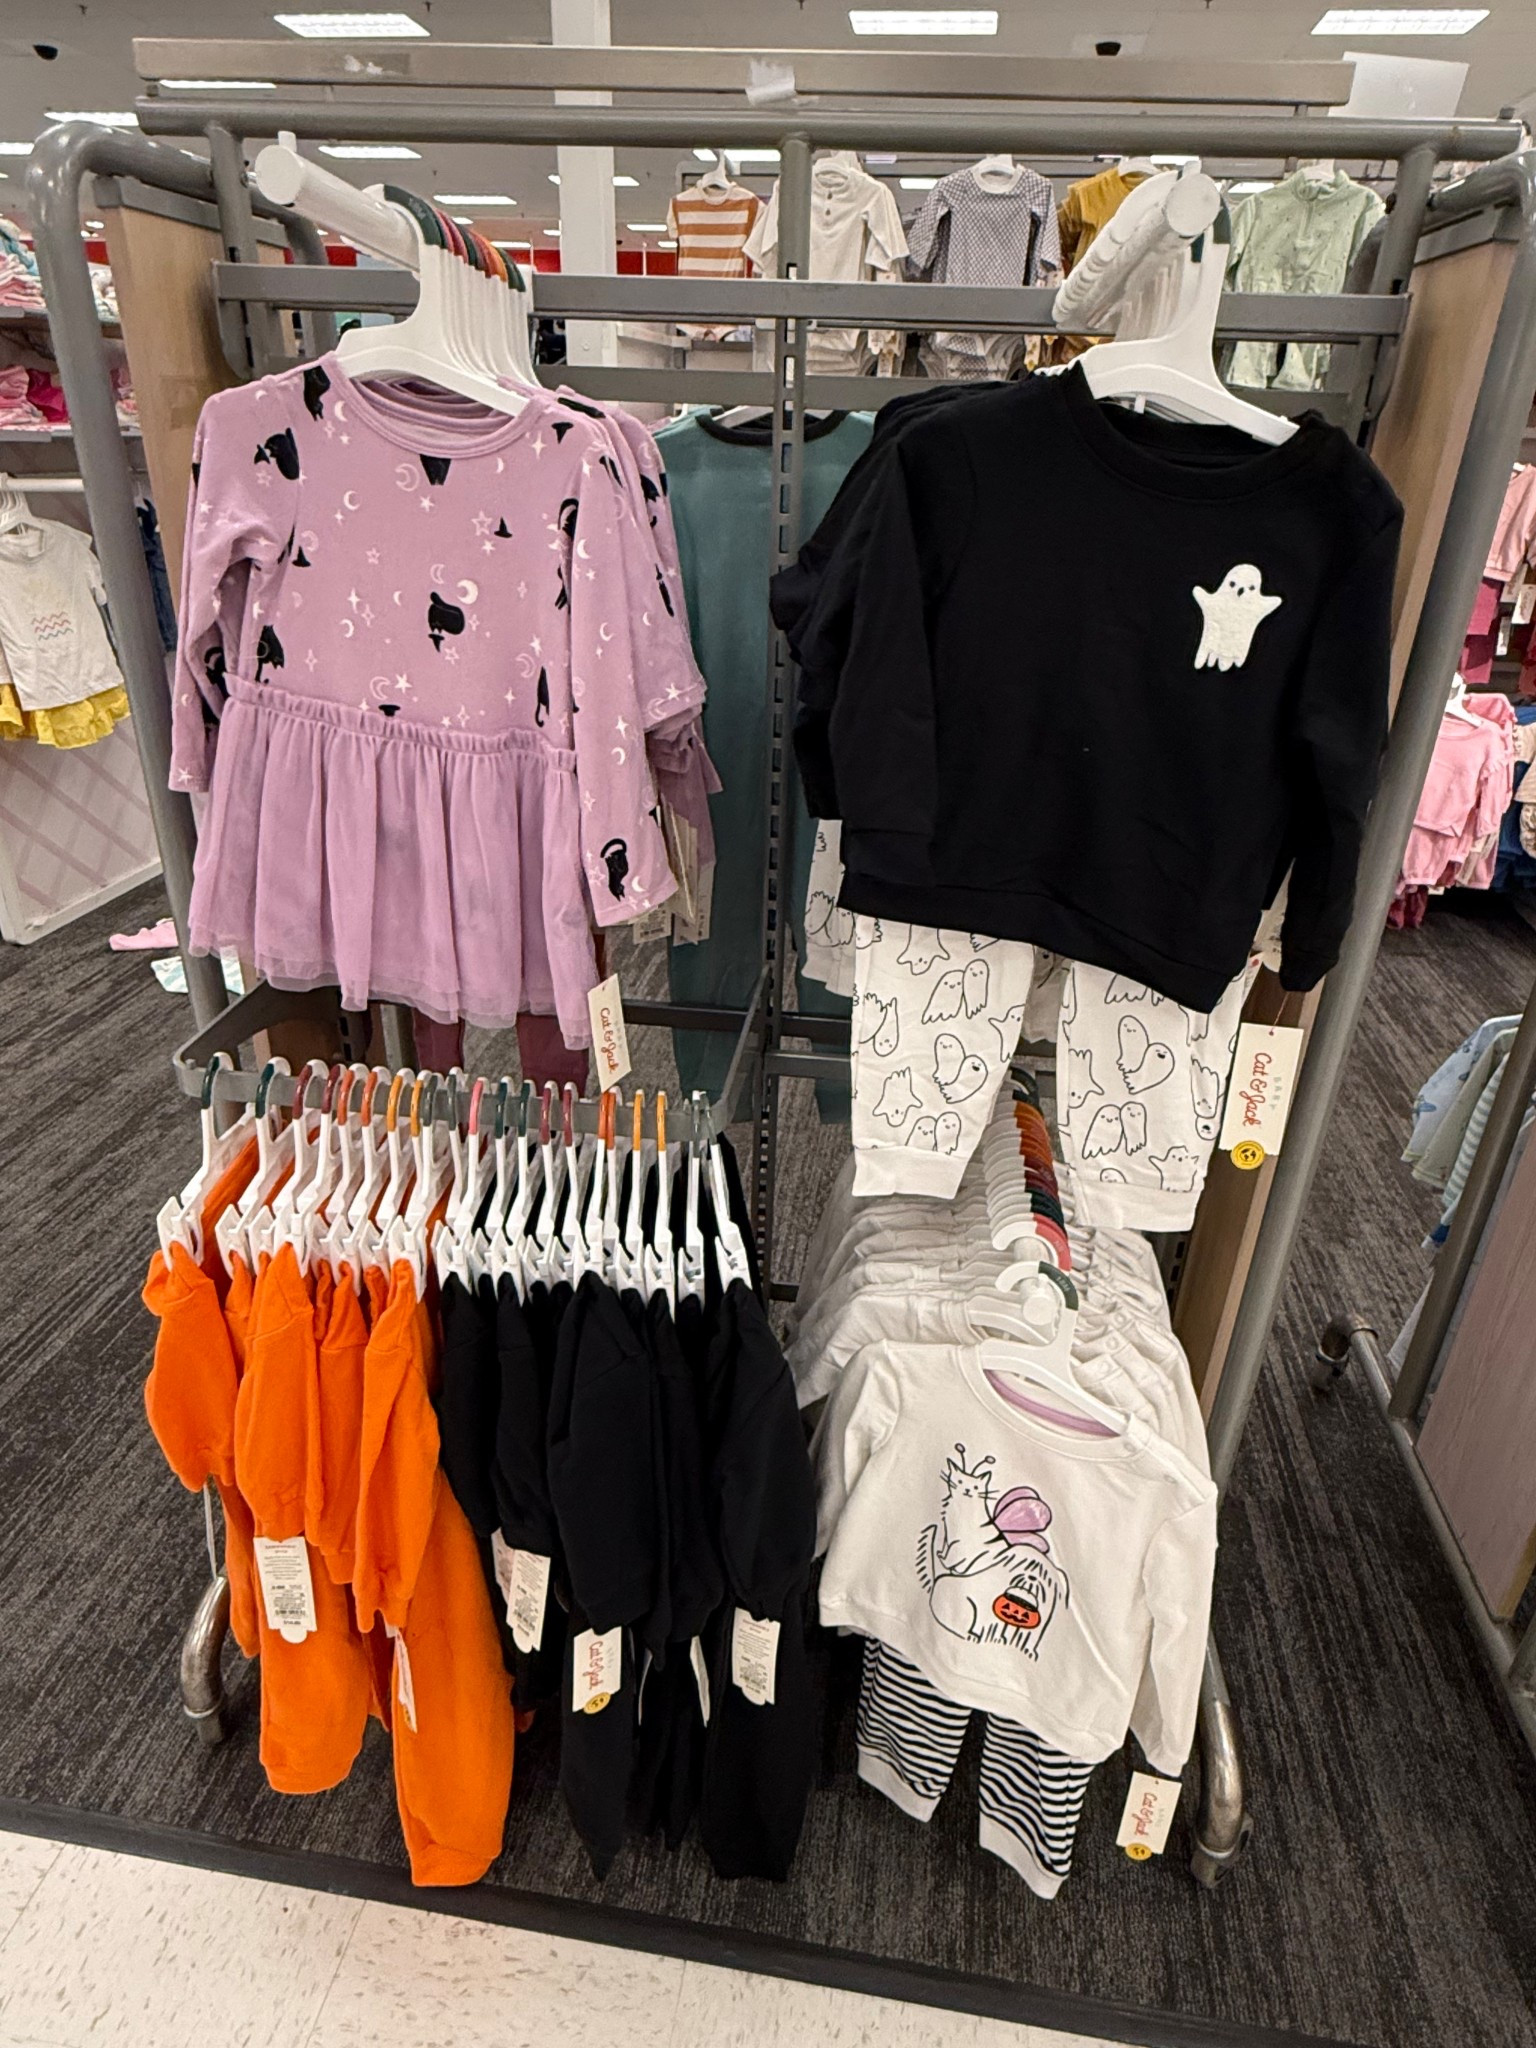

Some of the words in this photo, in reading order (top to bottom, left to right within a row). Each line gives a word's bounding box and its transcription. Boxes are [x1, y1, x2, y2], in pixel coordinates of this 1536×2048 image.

[600, 1007, 613, 1030] Cat
[601, 1042, 620, 1074] Jack
[1252, 1052, 1272, 1076] Cat
[1249, 1078, 1267, 1093] &
[1239, 1090, 1267, 1127] Jack
